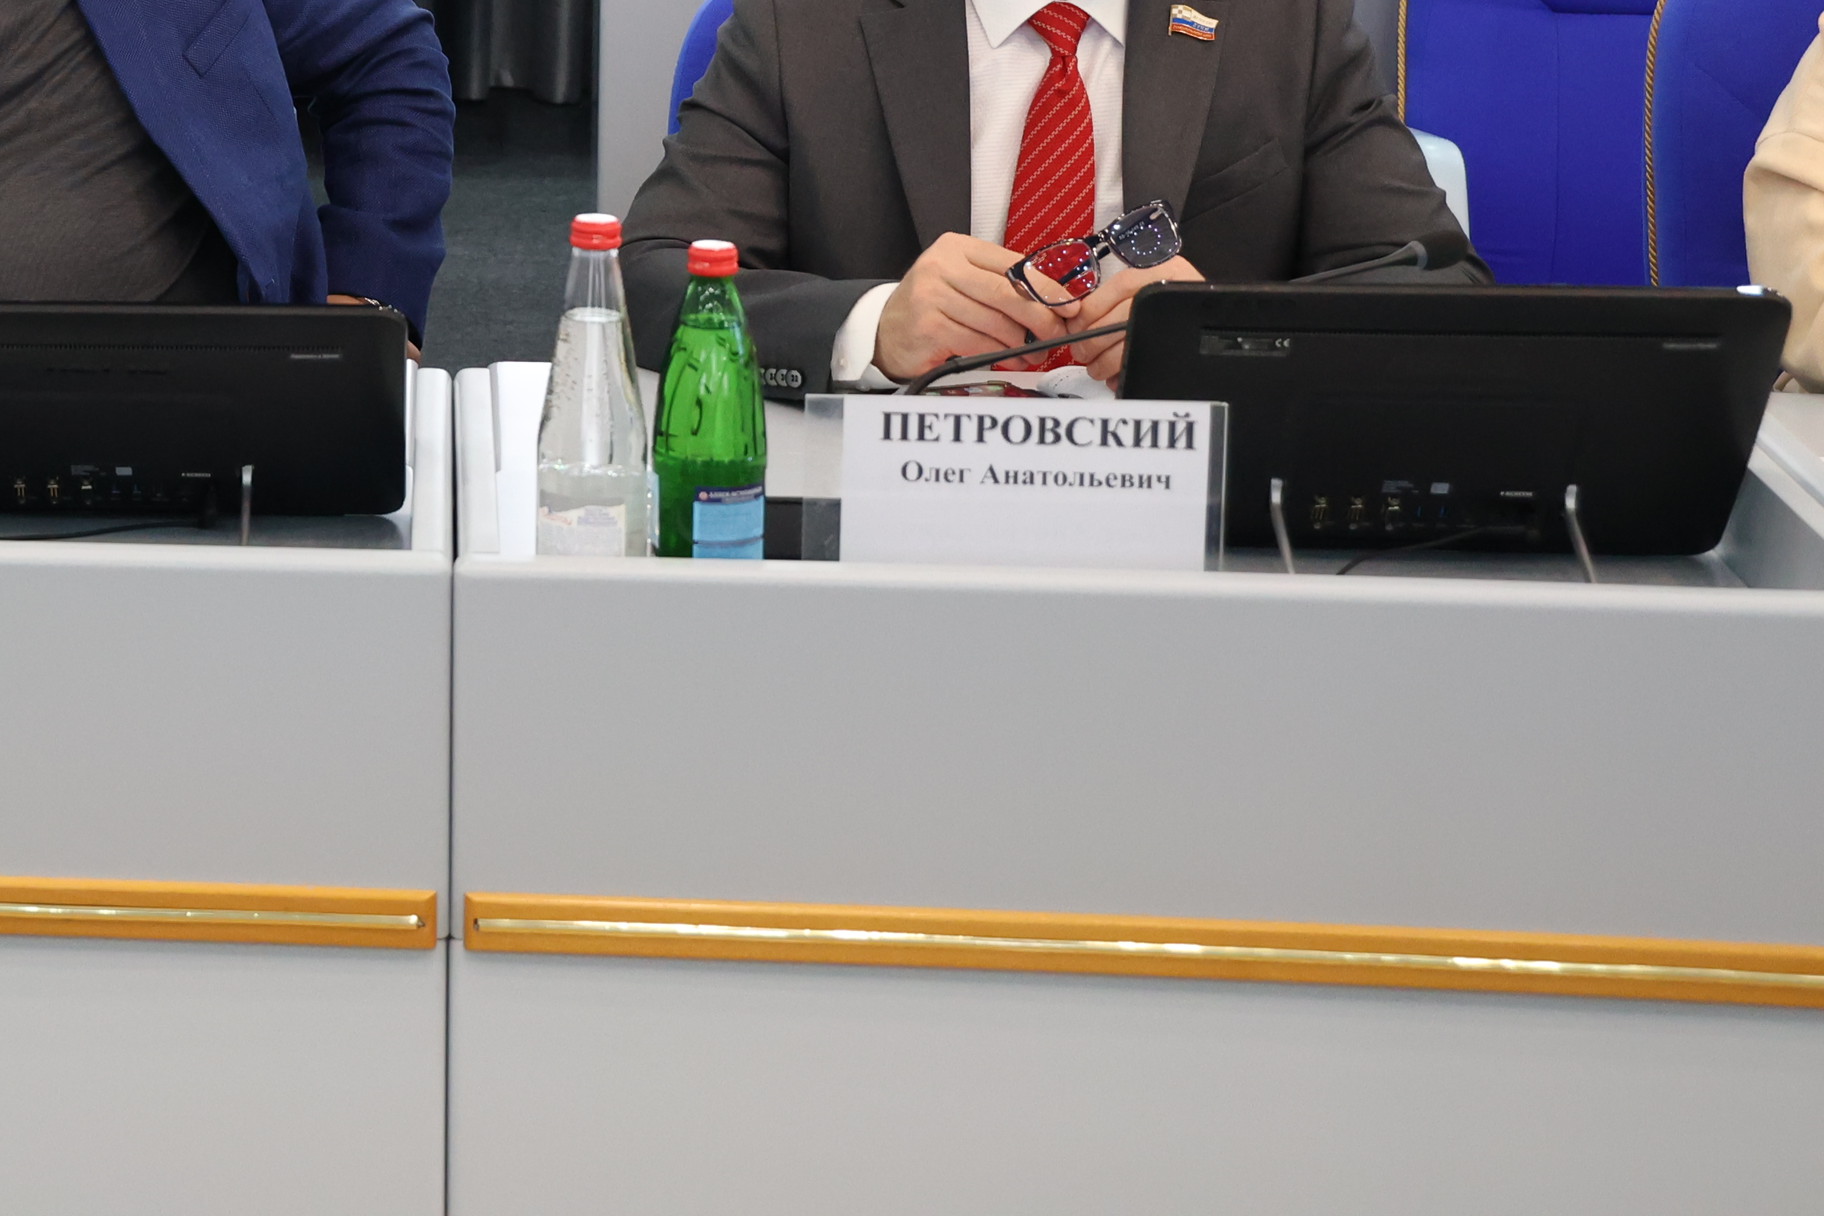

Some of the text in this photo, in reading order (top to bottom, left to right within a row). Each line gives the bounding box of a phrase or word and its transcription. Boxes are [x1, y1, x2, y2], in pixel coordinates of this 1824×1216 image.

[881, 411, 1197, 451] ПЕТРОВСКИЙ
[900, 460, 1172, 490] Олег Анатольевич
